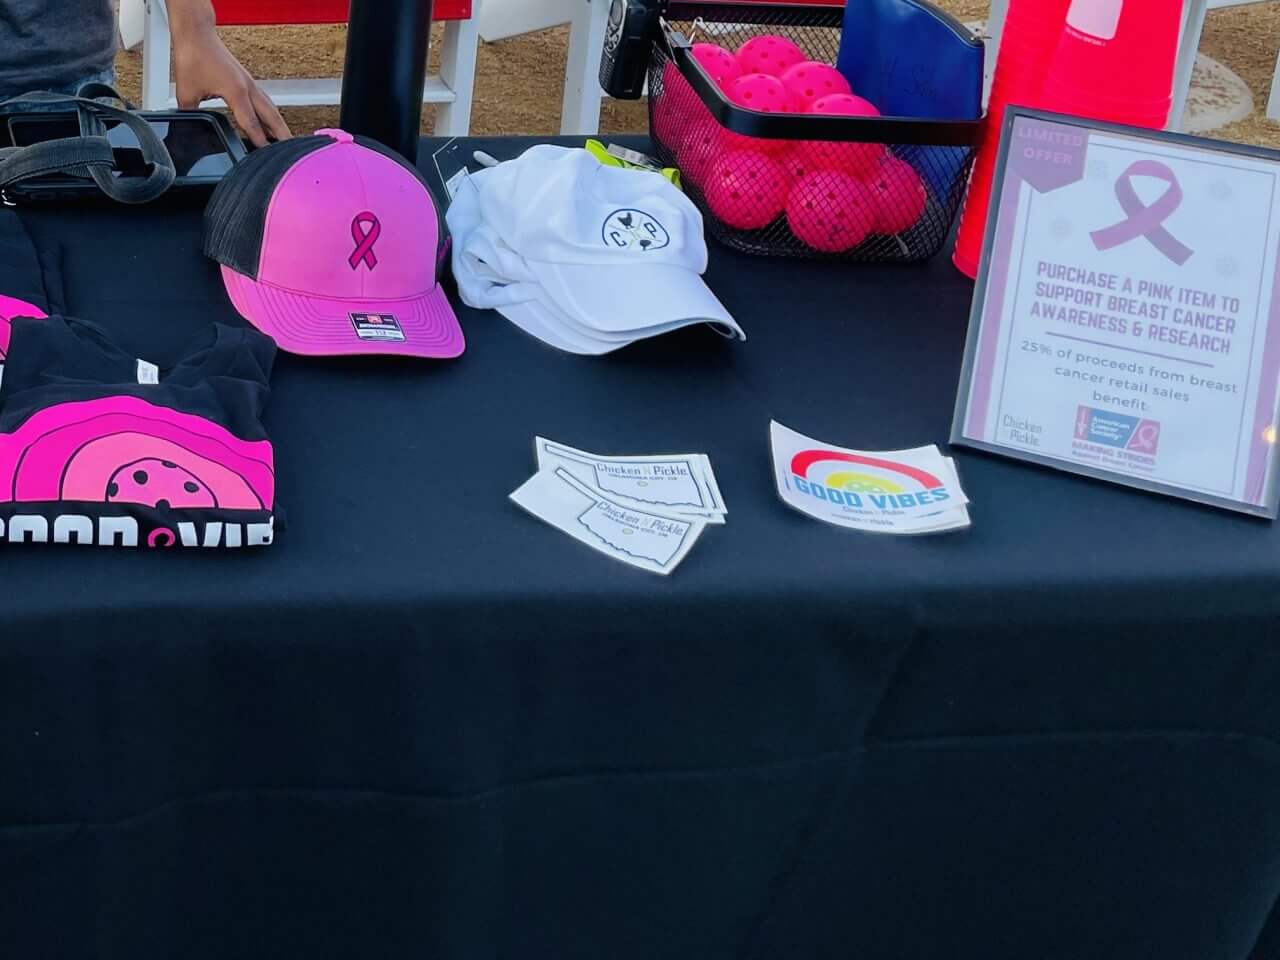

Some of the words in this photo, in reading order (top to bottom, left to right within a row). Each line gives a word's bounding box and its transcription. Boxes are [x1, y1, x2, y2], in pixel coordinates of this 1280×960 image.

[1018, 126, 1083, 146] LIMITED
[1022, 147, 1073, 165] OFFER
[1036, 260, 1119, 290] PURCHASE
[1122, 277, 1133, 294] A
[1137, 280, 1174, 302] PINK
[1177, 287, 1217, 310] ITEM
[1222, 295, 1241, 314] TO
[1035, 281, 1104, 309] SUPPORT
[1107, 295, 1169, 321] BREAST
[1172, 308, 1237, 335] CANCER
[1030, 301, 1129, 335] AWARENESS
[1131, 321, 1144, 337] &
[1147, 324, 1232, 354] RESEARCH
[1021, 340, 1053, 357] 25%
[1056, 348, 1072, 360] of
[1075, 352, 1144, 375] proceeds
[1148, 365, 1185, 383] from
[1189, 374, 1239, 394] breast
[1054, 365, 1105, 384] cancer
[1108, 377, 1149, 394] retail
[1152, 386, 1191, 403] sales
[1002, 413, 1043, 433] Chicken
[597, 462, 642, 476] Chicken
[793, 475, 864, 508] GOOD
[869, 488, 951, 510] VIBES
[596, 501, 642, 525] Chicken
